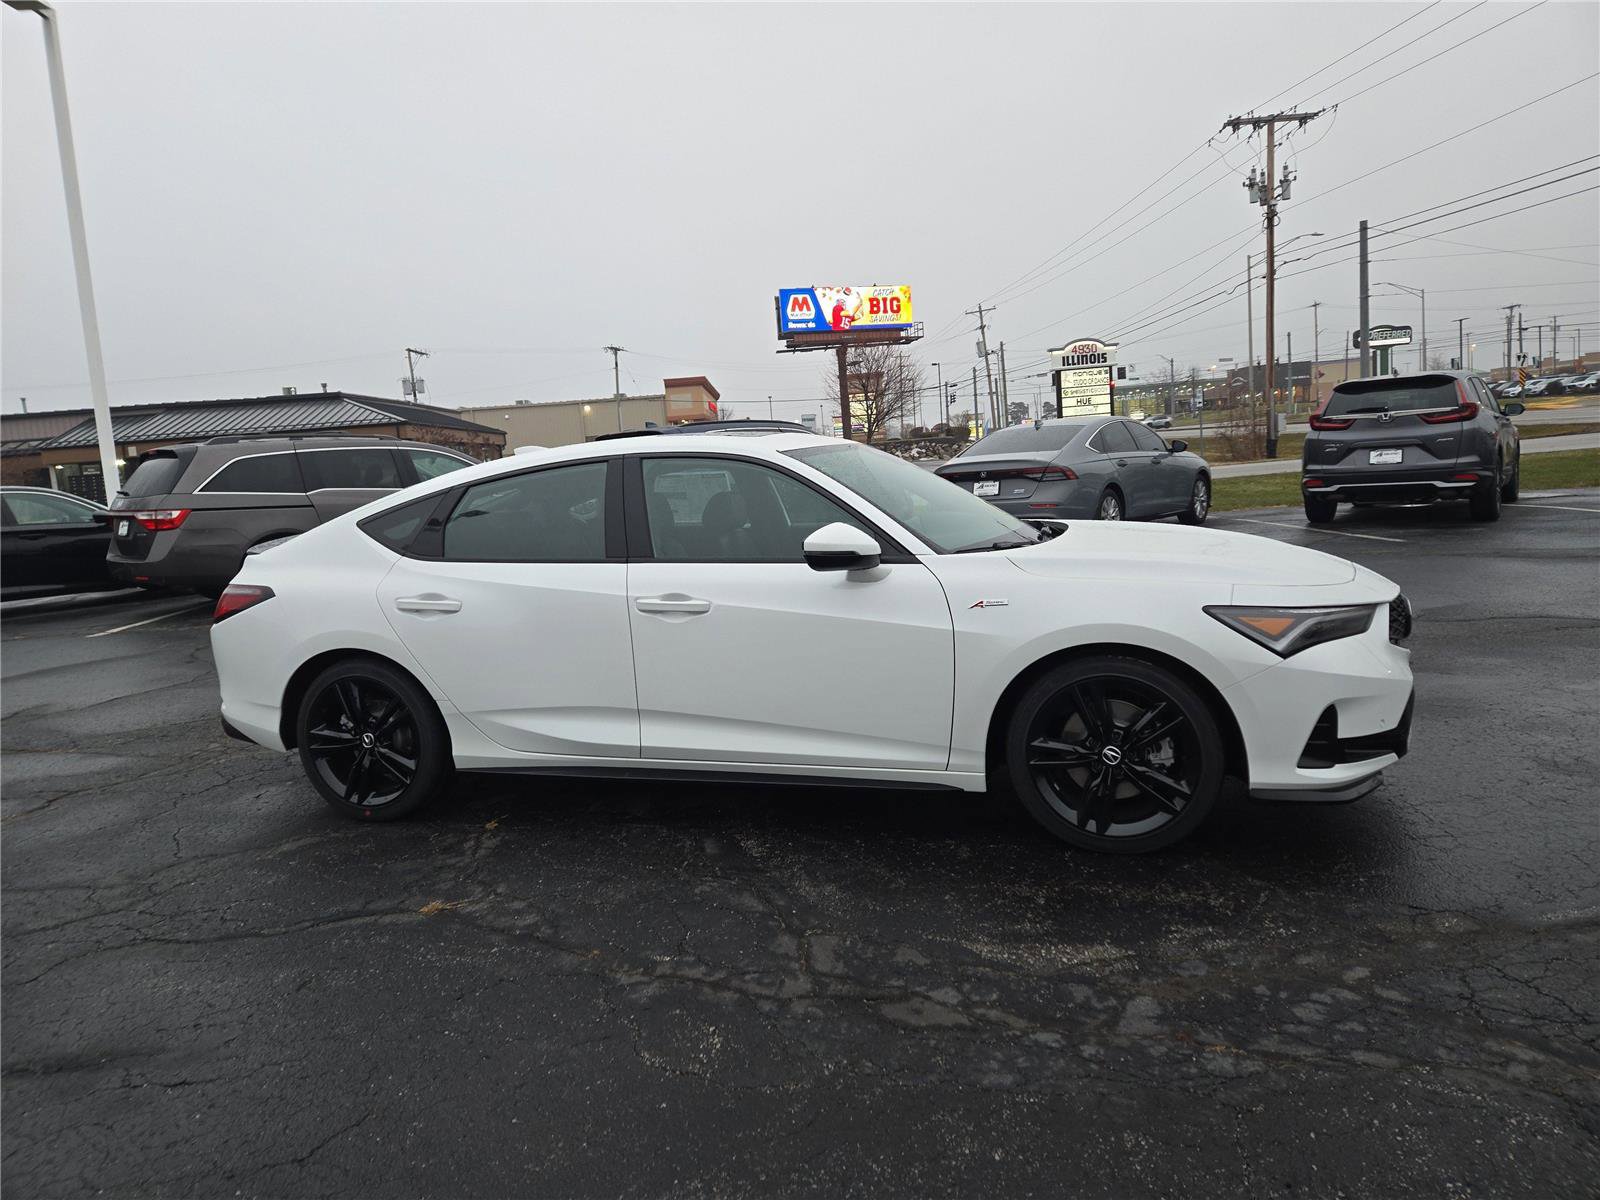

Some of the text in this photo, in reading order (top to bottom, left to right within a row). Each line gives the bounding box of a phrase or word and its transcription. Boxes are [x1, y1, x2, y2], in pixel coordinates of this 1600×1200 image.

[873, 288, 895, 297] CATCH
[868, 296, 901, 315] BIG
[840, 316, 850, 329] 15
[869, 313, 902, 324] SAVINGS!
[1071, 343, 1098, 355] 4930
[1062, 352, 1108, 367] ILLINOIS
[1076, 397, 1092, 406] HUE
